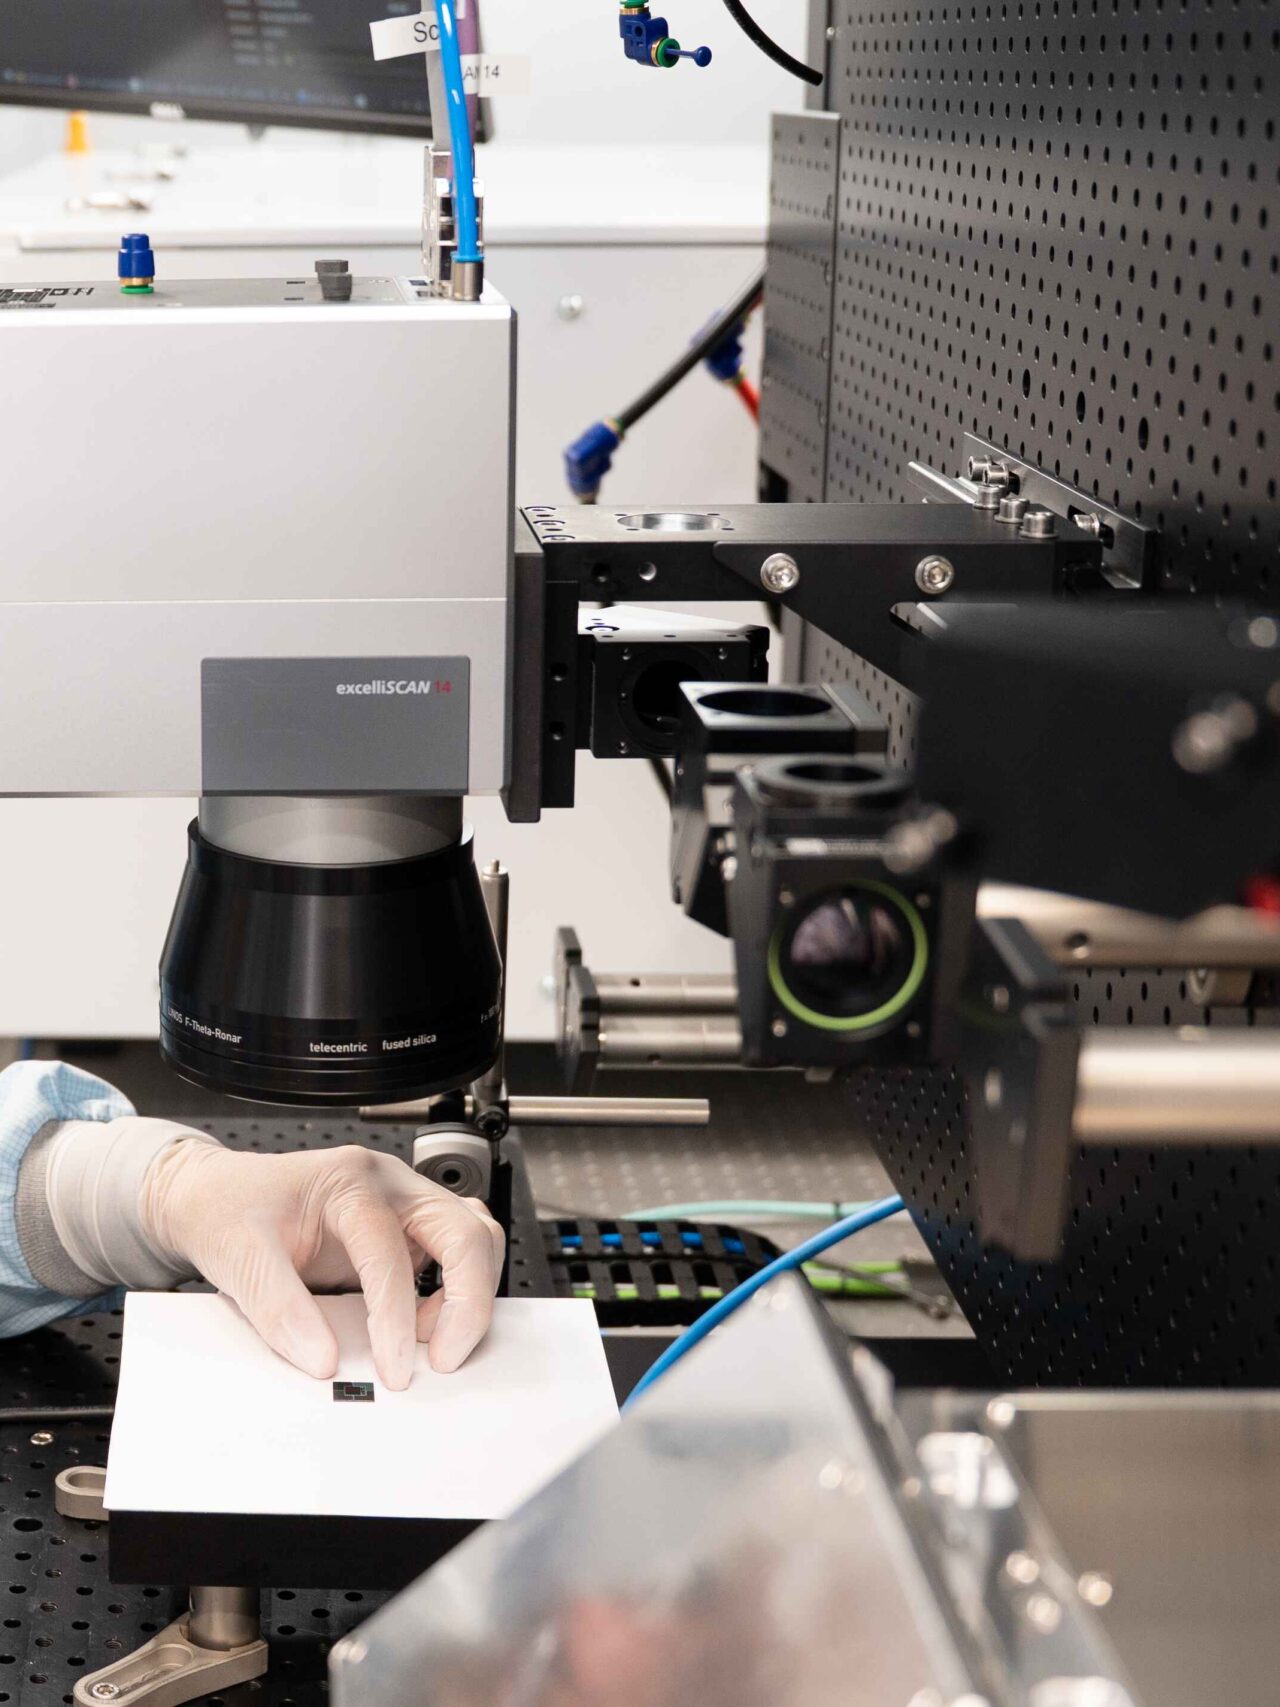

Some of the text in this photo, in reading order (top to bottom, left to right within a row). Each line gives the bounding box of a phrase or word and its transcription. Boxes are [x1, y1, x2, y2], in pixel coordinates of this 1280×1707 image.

[336, 680, 452, 694] excelliSCAN 14
[184, 1016, 242, 1043] F-Theta-Ronar
[309, 1034, 437, 1053] telecentric fused silica
